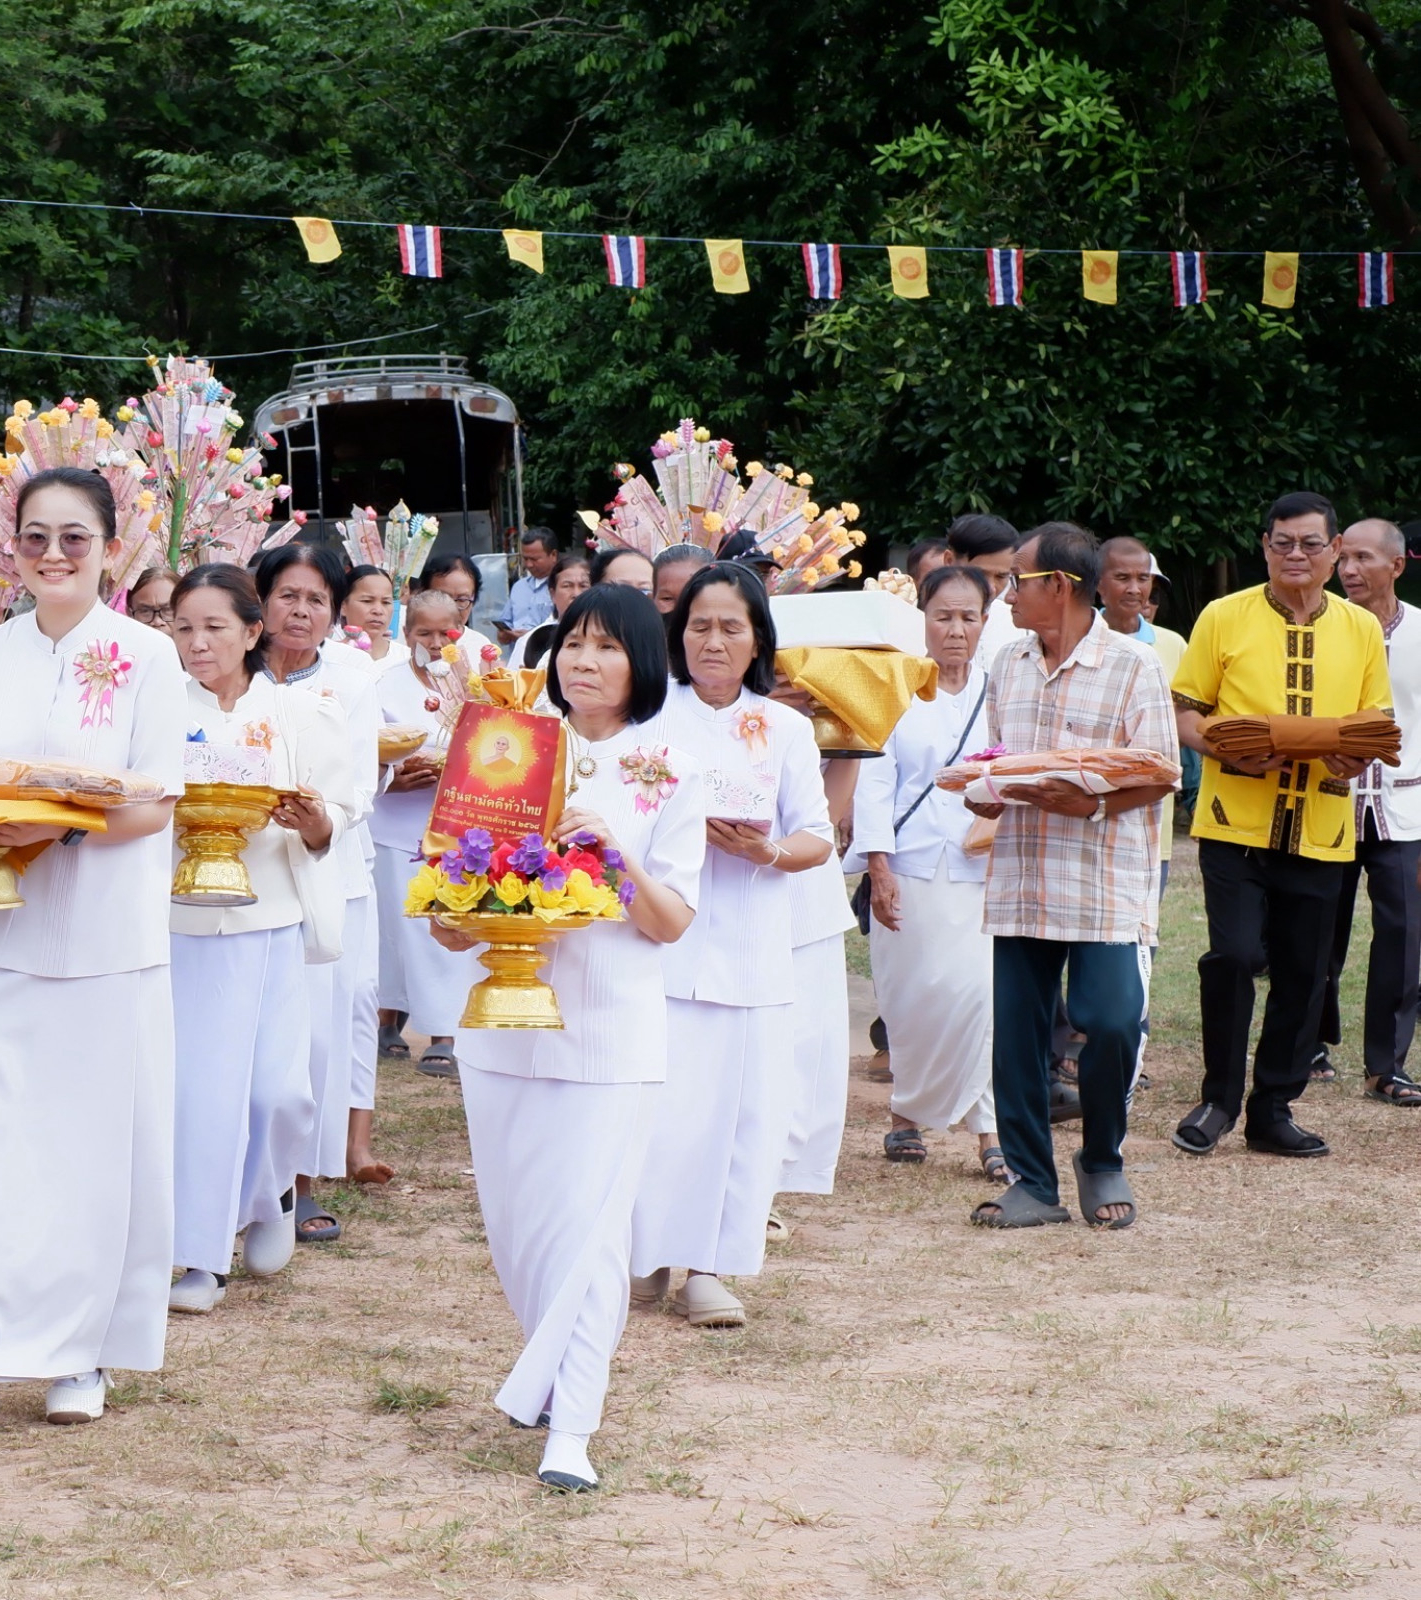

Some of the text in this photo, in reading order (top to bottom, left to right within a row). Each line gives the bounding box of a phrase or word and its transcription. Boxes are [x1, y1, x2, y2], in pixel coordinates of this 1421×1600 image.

[443, 786, 543, 816] กฐินสามัคคีทั่วไทย
